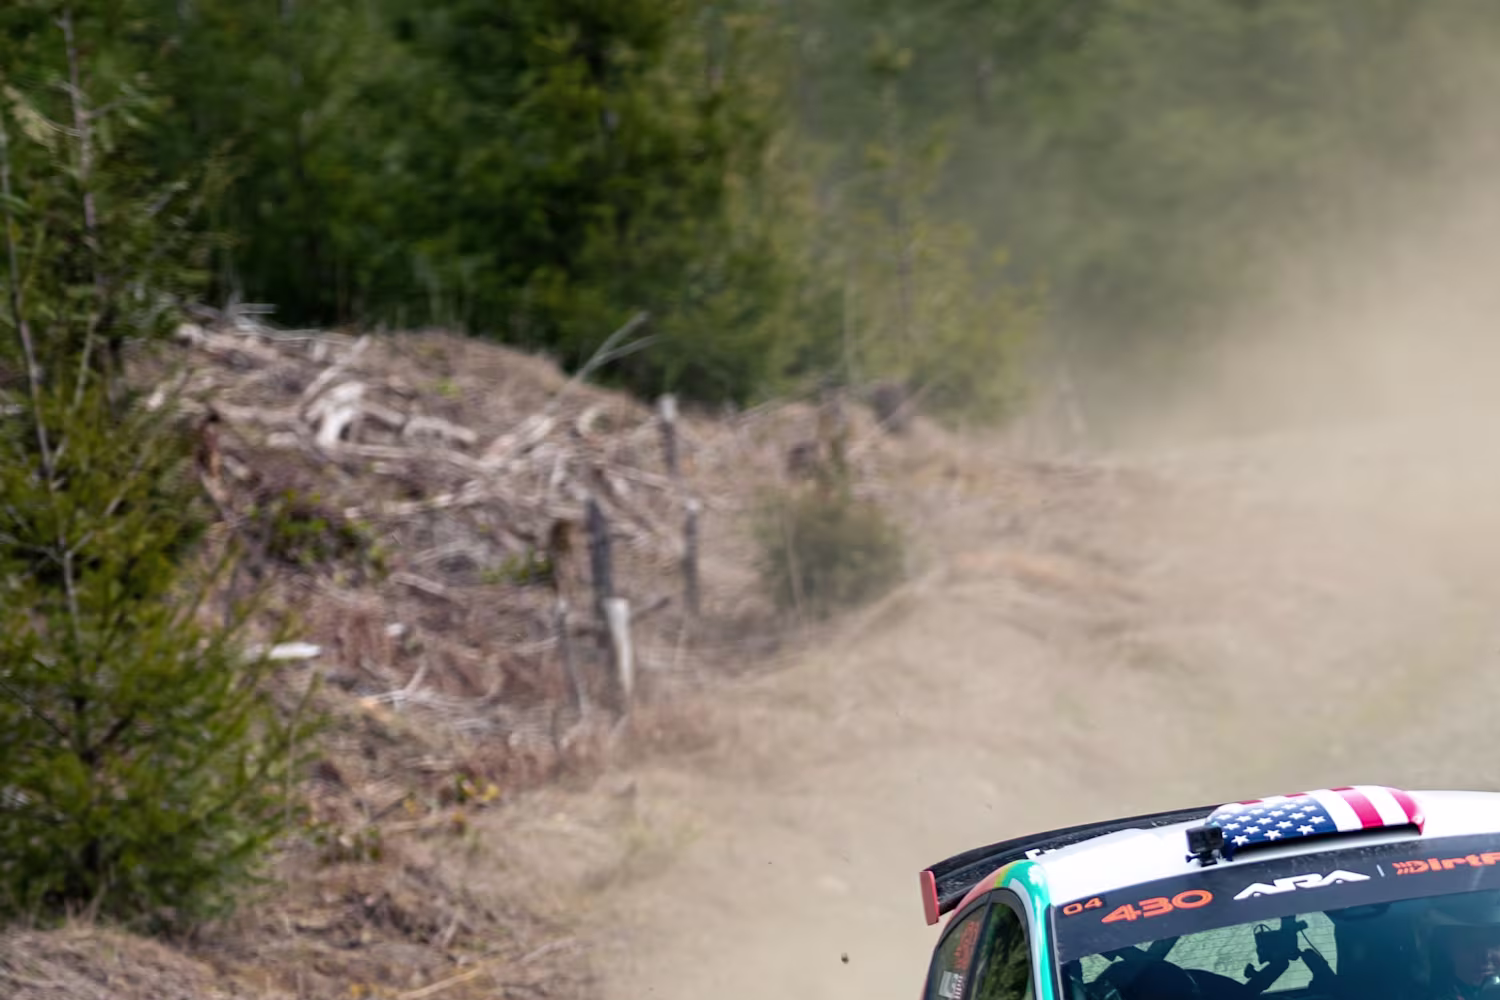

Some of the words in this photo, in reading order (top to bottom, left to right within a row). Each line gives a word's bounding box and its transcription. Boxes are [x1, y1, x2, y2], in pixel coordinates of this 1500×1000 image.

[1062, 897, 1103, 916] 04
[1100, 889, 1214, 924] 430
[1233, 869, 1371, 901] ARA
